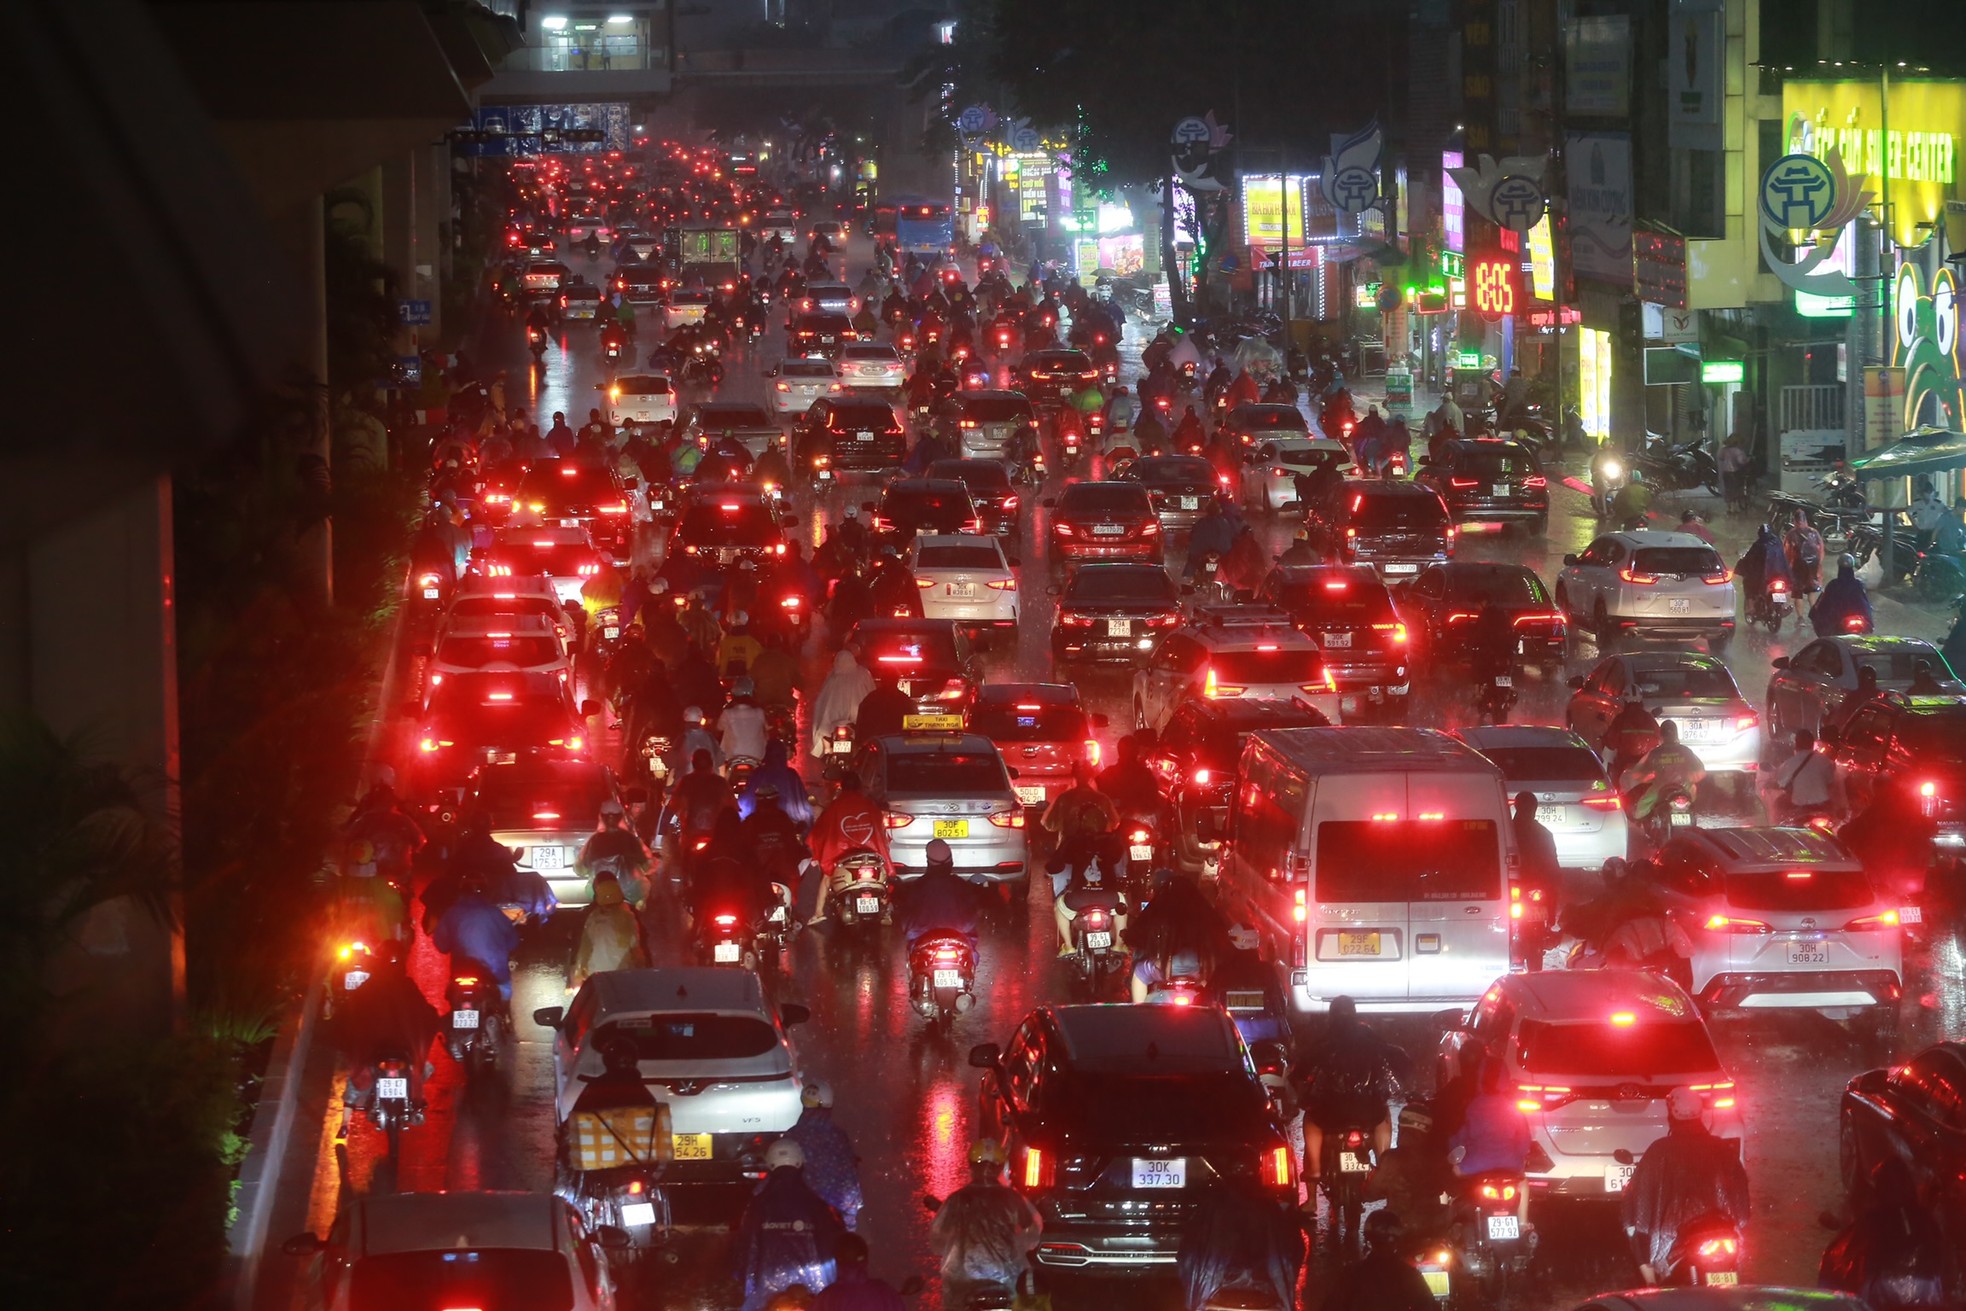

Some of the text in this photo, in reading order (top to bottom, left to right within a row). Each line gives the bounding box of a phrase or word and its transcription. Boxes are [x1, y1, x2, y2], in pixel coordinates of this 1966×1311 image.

[1476, 262, 1513, 313] 18:05
[1689, 721, 1703, 730] 30A
[1541, 807, 1557, 815] 30H
[943, 820, 958, 829] 30F
[937, 829, 965, 838] 802.51
[539, 847, 557, 858] 29A
[533, 858, 563, 869] 175.31
[1350, 935, 1369, 944] 29F
[1343, 944, 1377, 953] 022.64
[1799, 944, 1817, 953] 30H
[1791, 953, 1825, 963] 908.22
[676, 1135, 699, 1147] 29H
[1148, 1161, 1175, 1173] 30K
[1144, 1172, 1186, 1185] 337.30
[1491, 1218, 1514, 1227] 29-G1
[1490, 1227, 1519, 1237] 577.92
